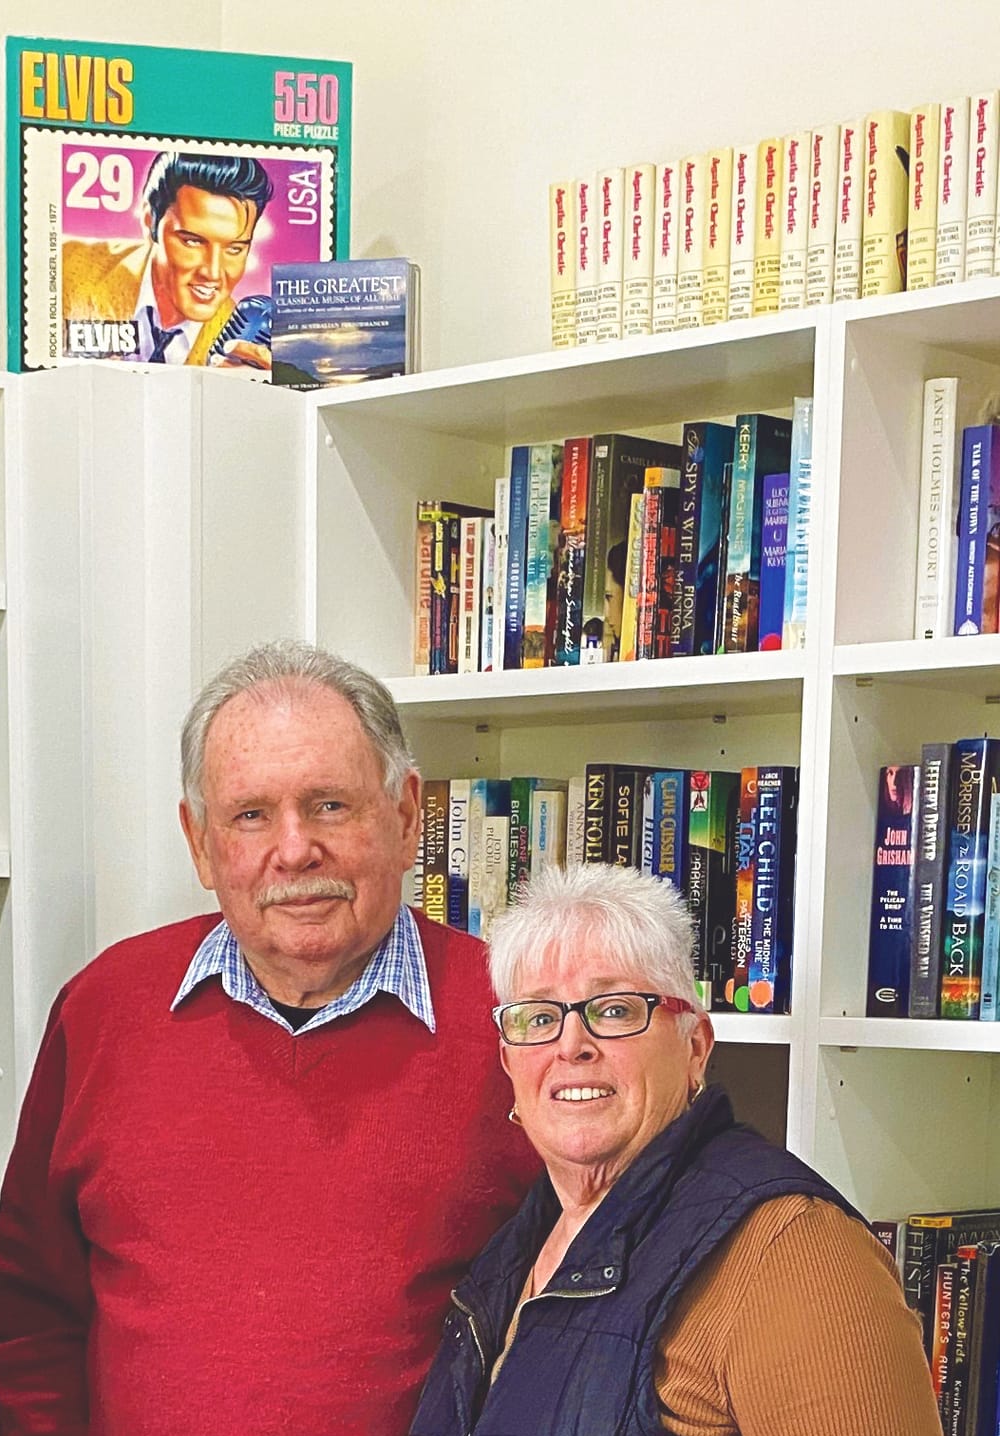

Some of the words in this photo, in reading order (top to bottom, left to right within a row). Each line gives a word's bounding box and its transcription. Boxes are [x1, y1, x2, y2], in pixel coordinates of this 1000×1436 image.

[20, 51, 134, 126] ELVIS
[273, 71, 339, 126] 550
[274, 123, 302, 138] PIECE
[304, 125, 339, 141] PUZZLE
[868, 121, 878, 166] Agatha
[914, 114, 926, 158] Agatha
[976, 98, 988, 143] Agatha
[765, 146, 777, 189] Agatha
[843, 128, 854, 172] Agatha
[975, 146, 986, 198] Christie
[65, 152, 134, 213] 29
[288, 169, 318, 226] USA
[632, 171, 643, 212] Agatha
[710, 157, 721, 200] Agatha
[840, 175, 852, 224] Christie
[867, 168, 877, 218] Christie
[914, 161, 925, 211] Christie
[49, 203, 57, 224] 1977
[555, 188, 565, 229] Agatha
[709, 202, 719, 249] Christie
[765, 192, 776, 239] Christie
[557, 231, 565, 276] Christie
[632, 215, 641, 261] Christie
[276, 279, 311, 296] THE
[313, 276, 402, 295] GREATEST
[276, 296, 321, 306] CLASSICAL
[322, 294, 349, 305] MUSIC
[363, 293, 377, 303] ALL
[69, 323, 137, 352] ELVIS
[933, 387, 945, 438] JANET
[571, 446, 579, 491] FRANCES
[738, 423, 751, 473] KERRY
[972, 442, 982, 468] TALK
[683, 461, 698, 513] SPY'S
[771, 488, 789, 500] LUCY
[929, 444, 943, 513] HOLMES
[680, 515, 695, 565] WIFE
[969, 505, 979, 535] TOWN
[927, 526, 939, 581] COURT
[509, 562, 519, 610] DROVER'S
[682, 584, 695, 631] FIONA
[564, 595, 576, 655] Sunlight
[732, 588, 743, 644] Roadhouse
[587, 773, 605, 811] KEN
[661, 777, 678, 816] CLIVE
[757, 779, 782, 787] REACHER
[926, 759, 942, 811] JEFFERY
[958, 752, 977, 840] MORRISSEY
[426, 796, 437, 865] HAMMER
[435, 807, 445, 854] CHRIS
[450, 796, 467, 842] John
[511, 800, 520, 825] BIG
[616, 785, 631, 838] SOFIE
[759, 792, 777, 836] LEE
[485, 826, 495, 875] PICOULT
[493, 837, 502, 866] JODI
[509, 826, 519, 859] LIES
[658, 819, 677, 874] CUSSLER
[876, 846, 915, 866] GRISHAM
[884, 827, 908, 846] JOHN
[924, 814, 939, 862] DEAVER
[755, 840, 776, 913] CHILD
[886, 889, 898, 897] THE
[920, 883, 933, 902] THE
[953, 859, 971, 918] ROAD
[879, 896, 905, 904] PELICAN
[884, 903, 902, 911] BRIEF
[737, 899, 748, 968] PATTERSON
[763, 916, 772, 937] THE
[918, 904, 934, 955] VANISHED
[949, 923, 968, 976] BACK
[754, 940, 764, 964] LINE
[907, 1231, 923, 1300] FEIST
[959, 1258, 971, 1282] The
[939, 1271, 953, 1344] HUNTER'S
[958, 1283, 970, 1330] Yellow
[938, 1354, 949, 1384] RUN
[955, 1331, 968, 1364] Birds
[953, 1379, 963, 1409] Kevin
